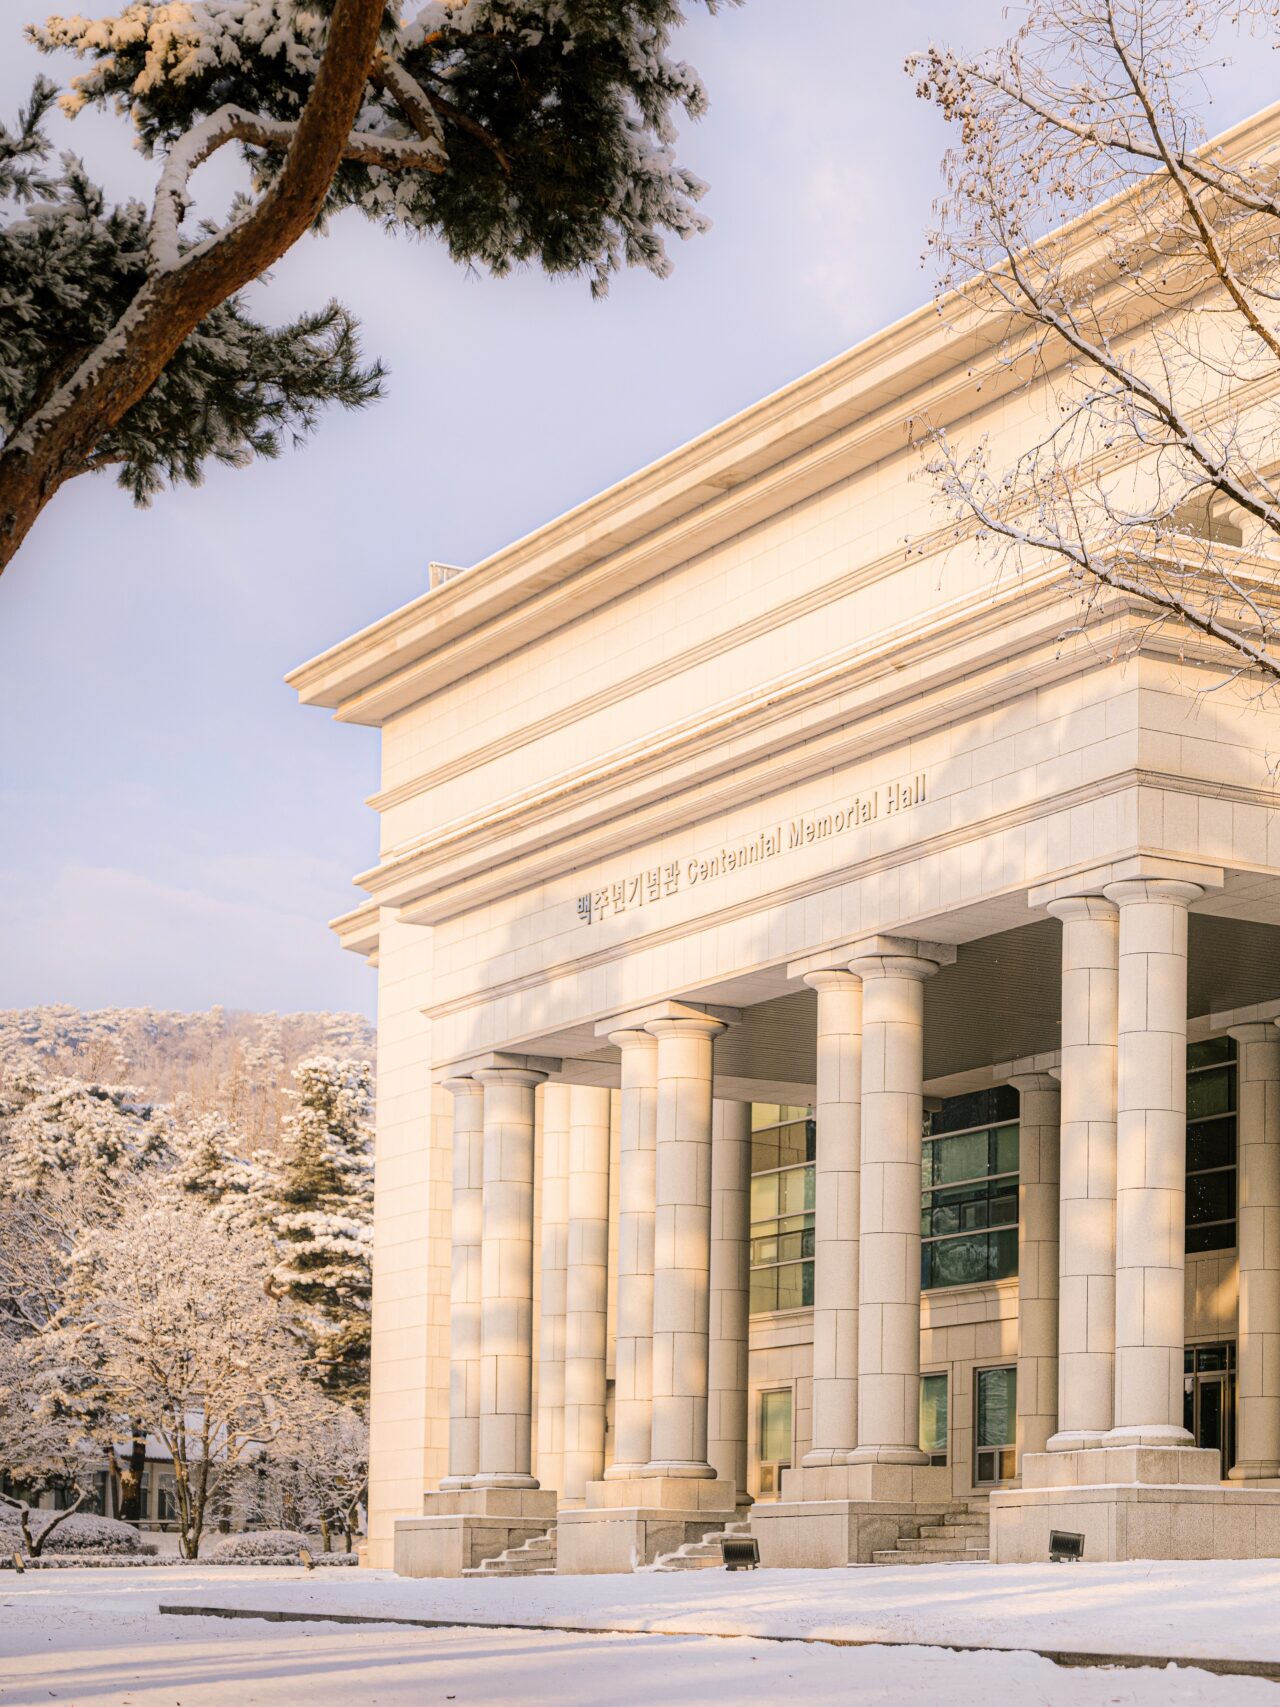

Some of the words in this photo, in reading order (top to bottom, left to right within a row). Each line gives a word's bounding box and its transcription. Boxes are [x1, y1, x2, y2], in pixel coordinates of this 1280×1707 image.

[577, 860, 680, 925] 백주년기념관
[688, 827, 781, 885] Centennial
[788, 791, 878, 849] Memorial
[886, 773, 926, 814] Hall
